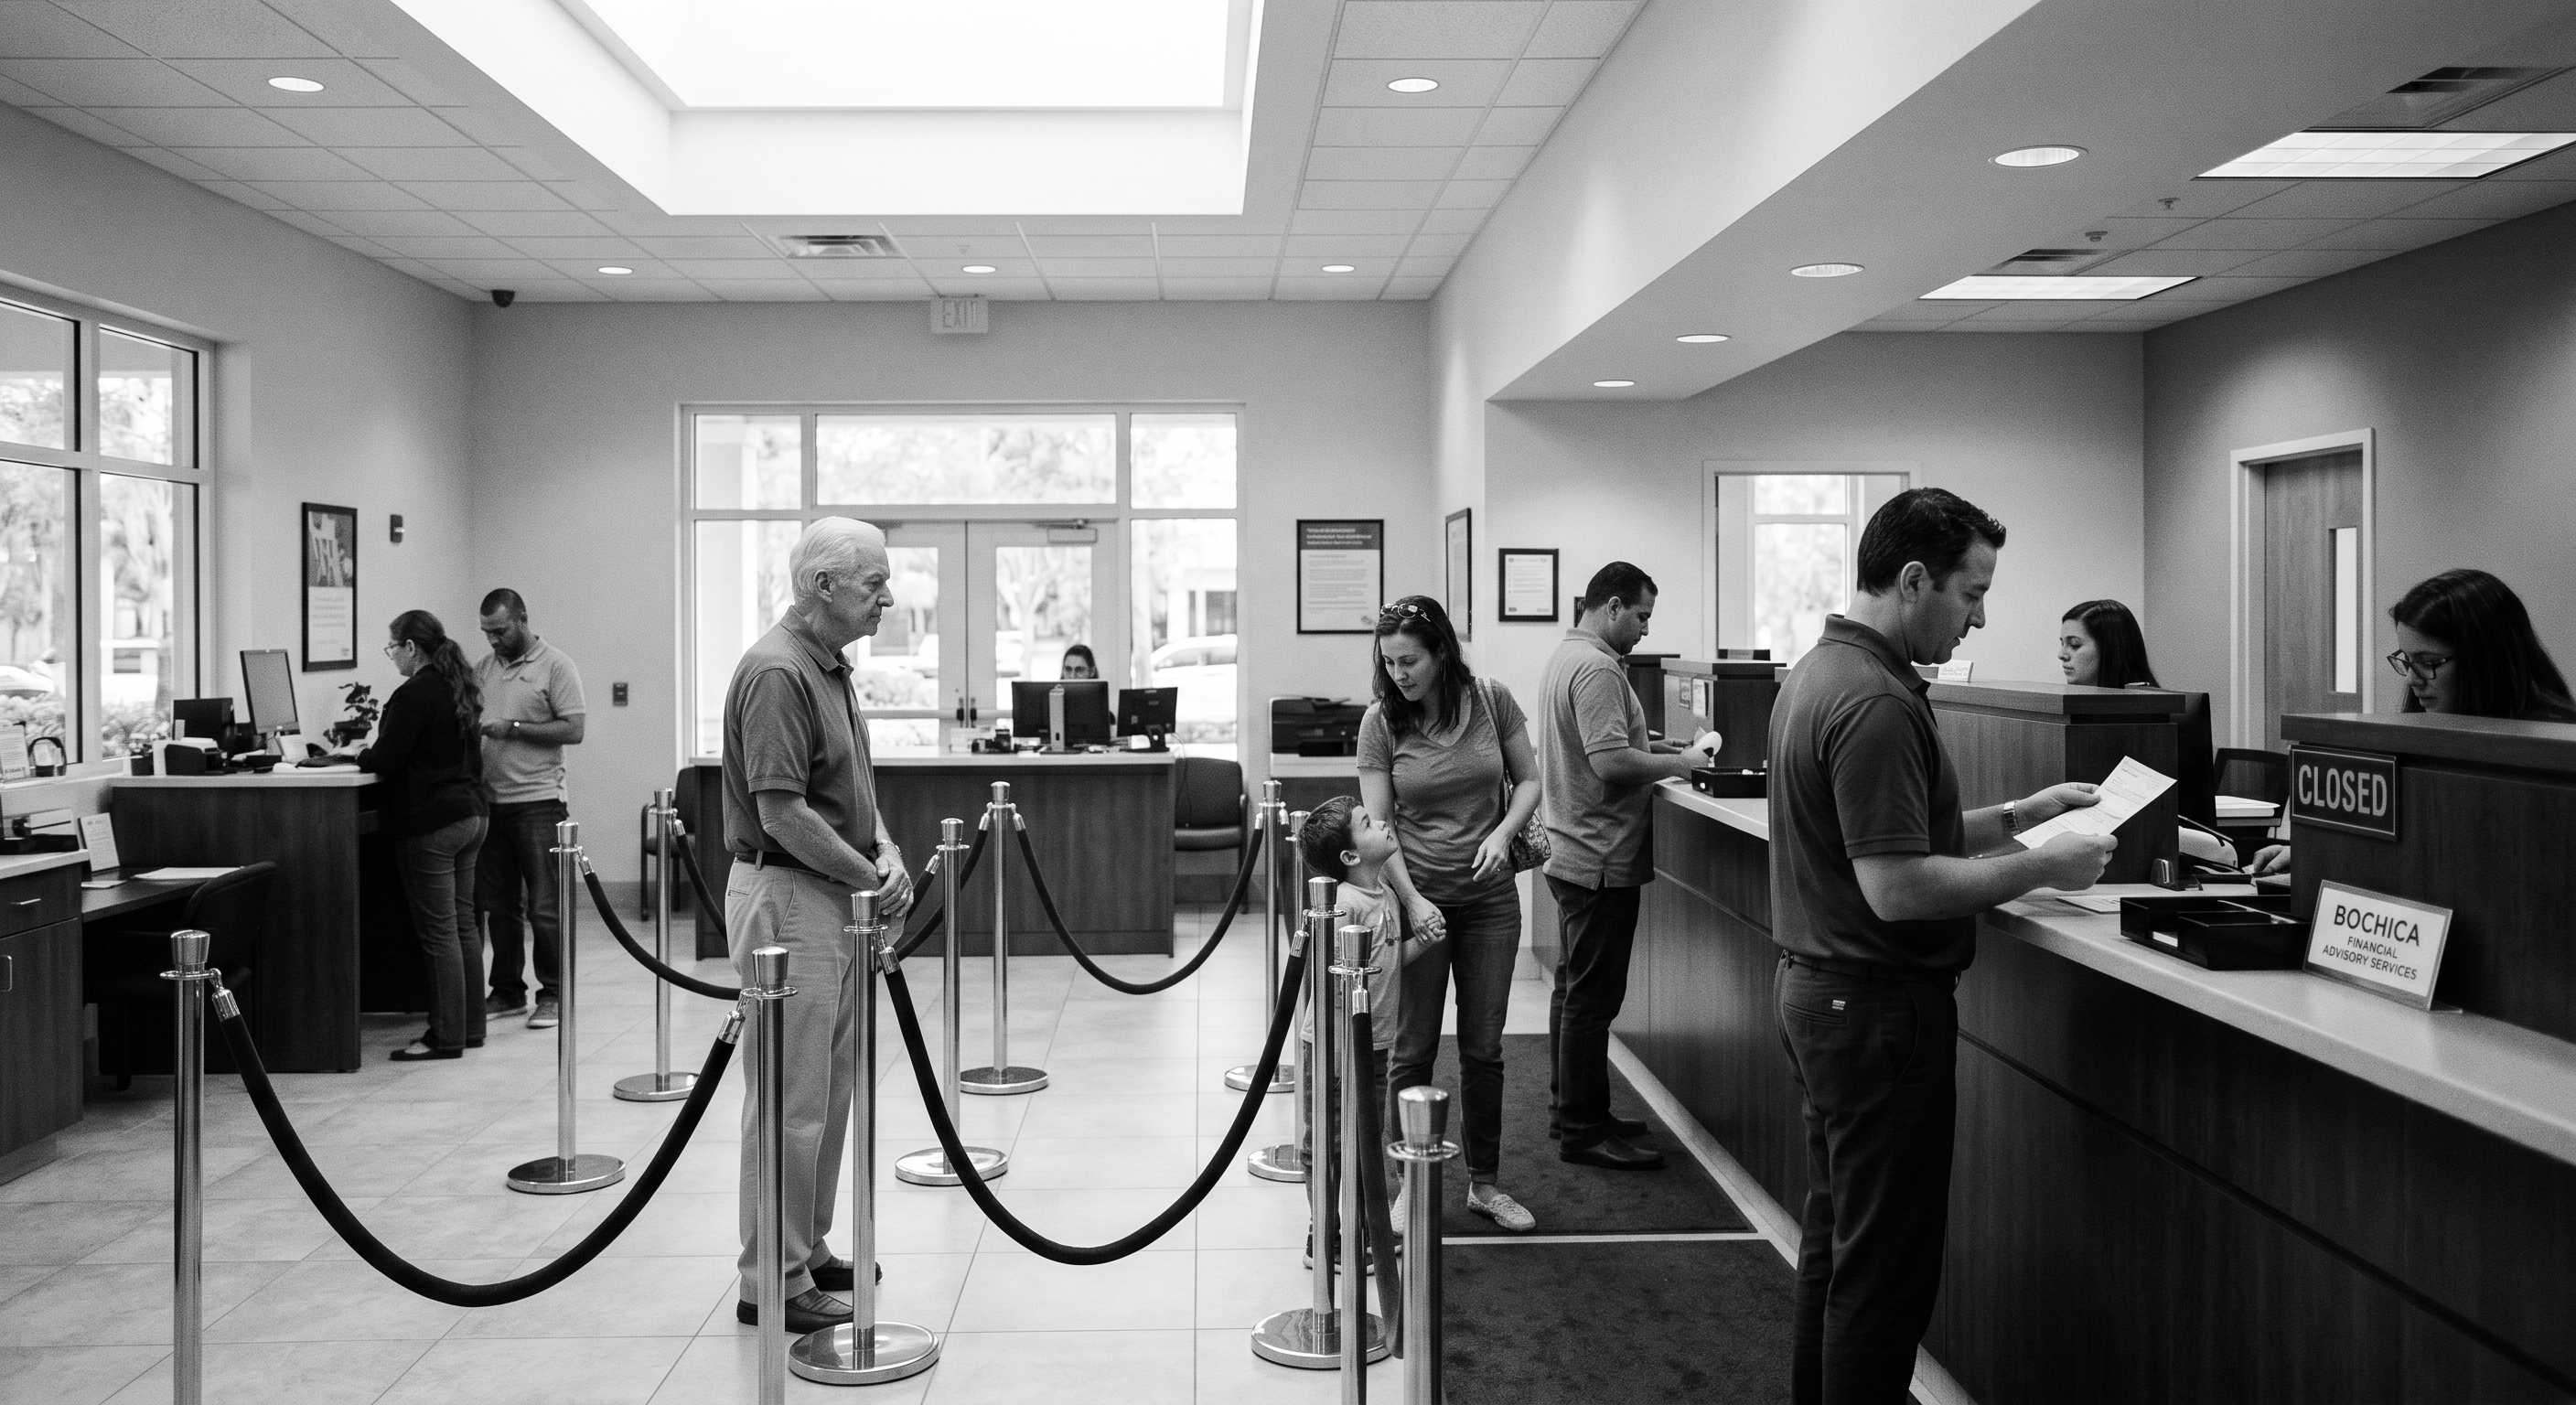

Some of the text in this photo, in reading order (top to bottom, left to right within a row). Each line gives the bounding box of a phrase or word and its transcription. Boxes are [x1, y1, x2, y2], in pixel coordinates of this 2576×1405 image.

[941, 300, 979, 329] EXIT
[2298, 764, 2388, 817] CLOSED
[2334, 905, 2420, 947] BOCHICA
[2322, 944, 2417, 980] ADVISORY SERVICES
[2347, 936, 2398, 958] FINANCIAL
